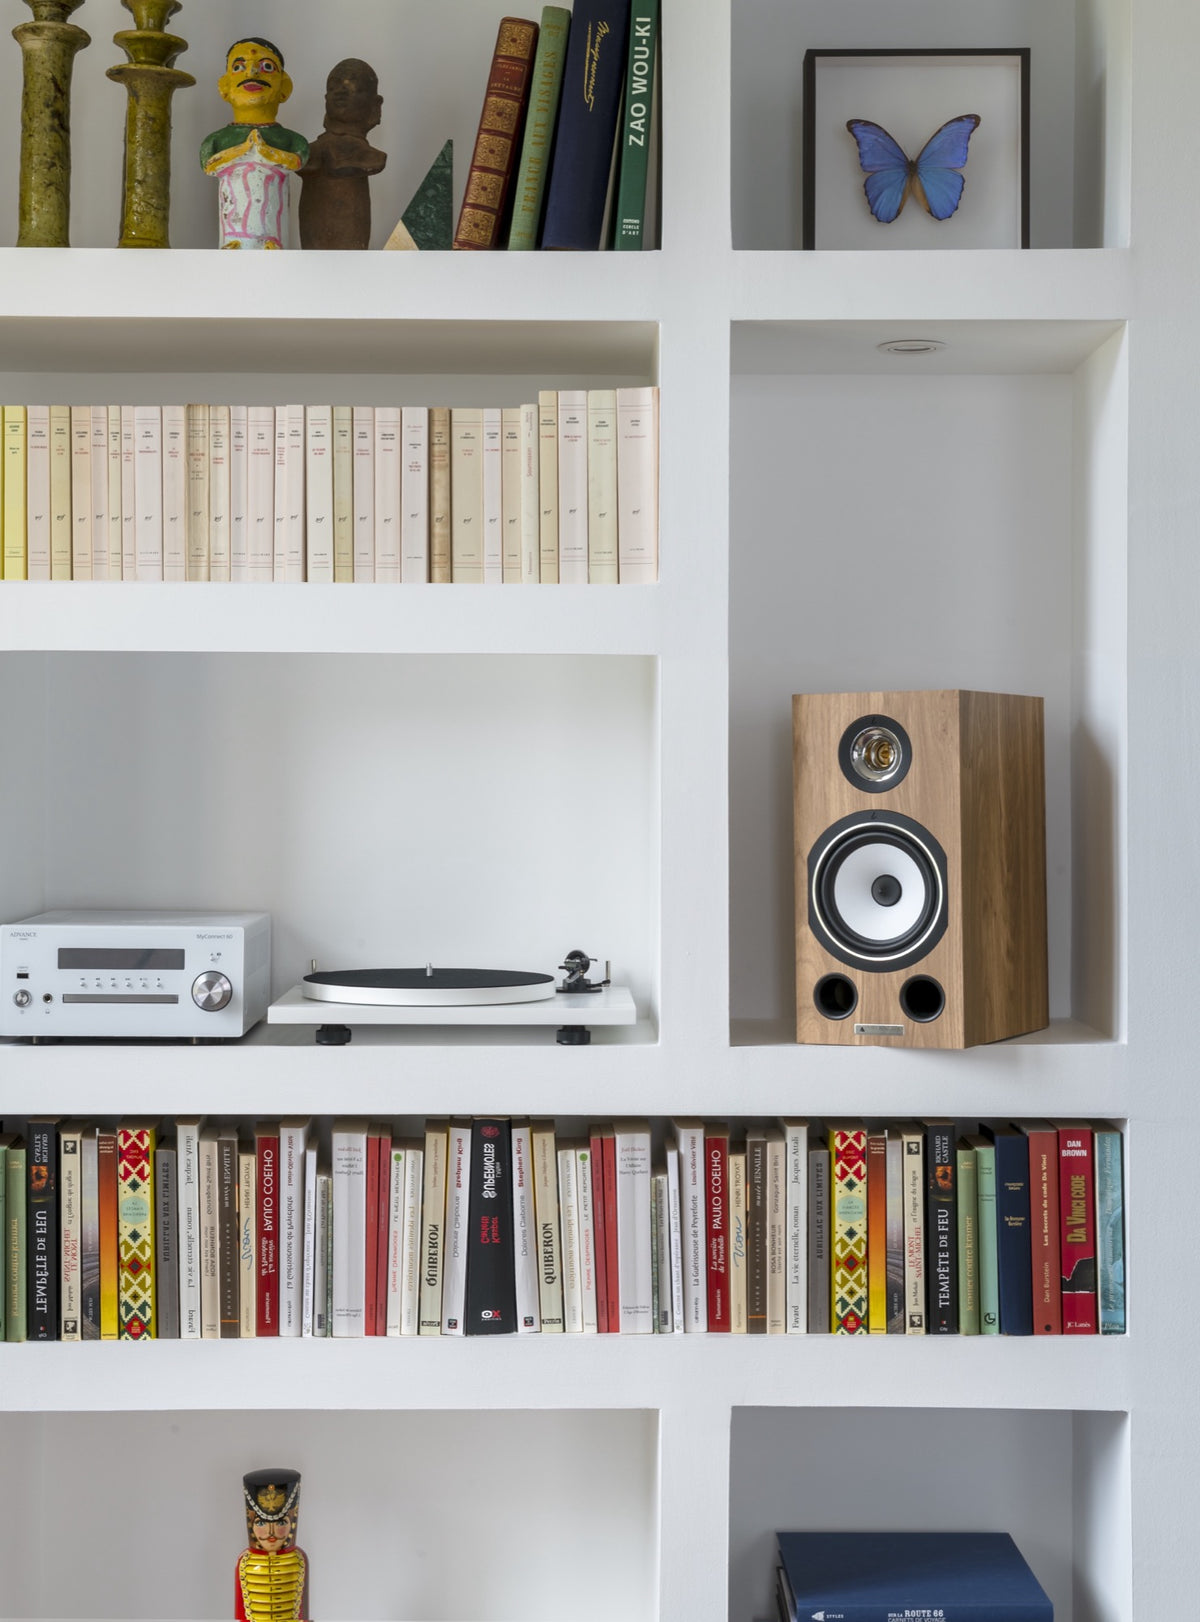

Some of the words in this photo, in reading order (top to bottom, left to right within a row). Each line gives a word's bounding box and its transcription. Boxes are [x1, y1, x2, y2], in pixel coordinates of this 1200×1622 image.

[632, 17, 651, 95] WOU-KI
[629, 102, 647, 147] ZAO
[712, 1150, 721, 1193] COELHO
[792, 1159, 800, 1184] Jacques
[1042, 1172, 1047, 1181] Da
[1071, 1175, 1085, 1196] CODE
[712, 1197, 722, 1229] PAULO
[938, 1209, 948, 1231] FEU
[692, 1230, 698, 1238] de
[939, 1234, 948, 1247] DE
[543, 1223, 556, 1284] QUIBERON
[910, 1259, 916, 1267] LE
[914, 1226, 922, 1278] SAINT-MICHEL
[712, 1262, 718, 1270] La
[719, 1264, 725, 1273] de
[792, 1276, 800, 1284] La
[937, 1252, 949, 1308] TEMPÊTE
